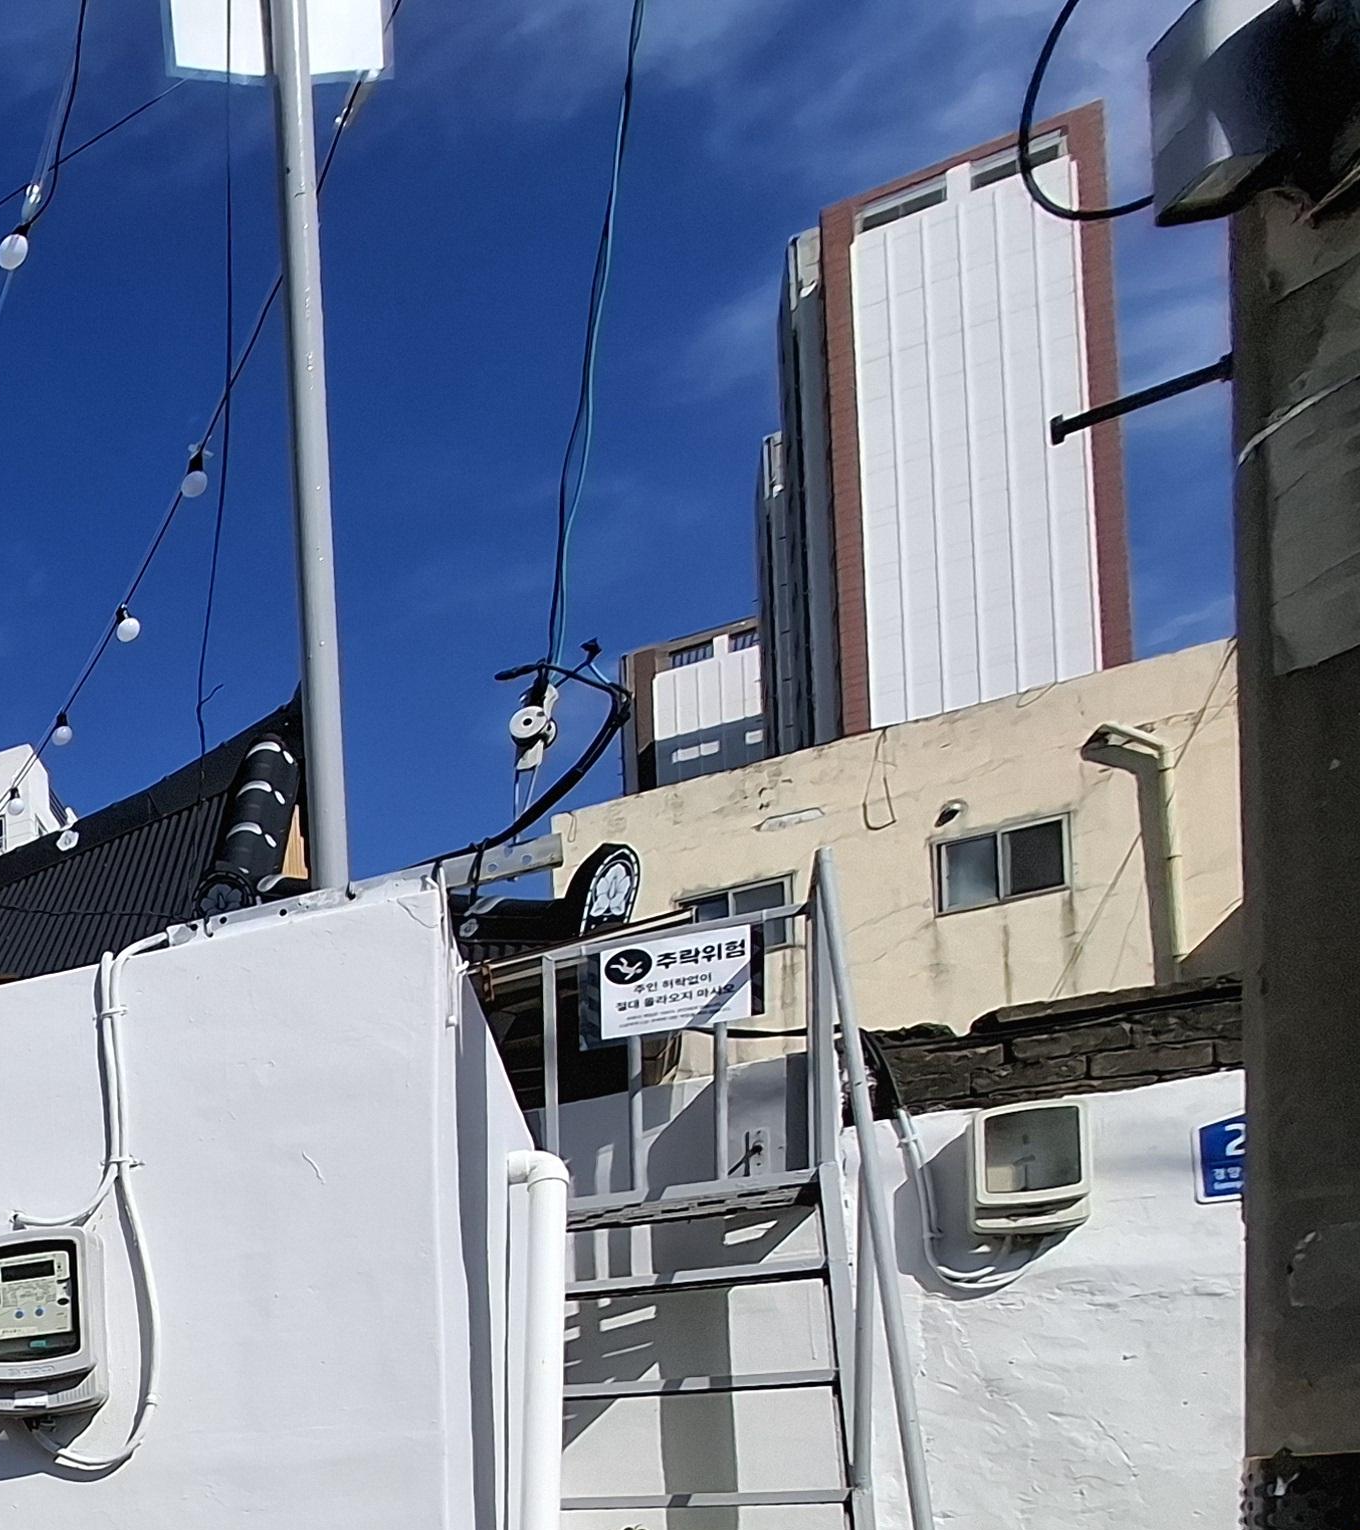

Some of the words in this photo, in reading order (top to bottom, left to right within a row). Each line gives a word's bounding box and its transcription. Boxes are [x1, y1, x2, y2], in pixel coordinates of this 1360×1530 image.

[656, 939, 746, 969] 추락위험
[634, 982, 658, 994] 주인
[662, 972, 712, 989] 허락없이
[697, 984, 735, 998] 마시오
[1224, 1123, 1247, 1156] 2
